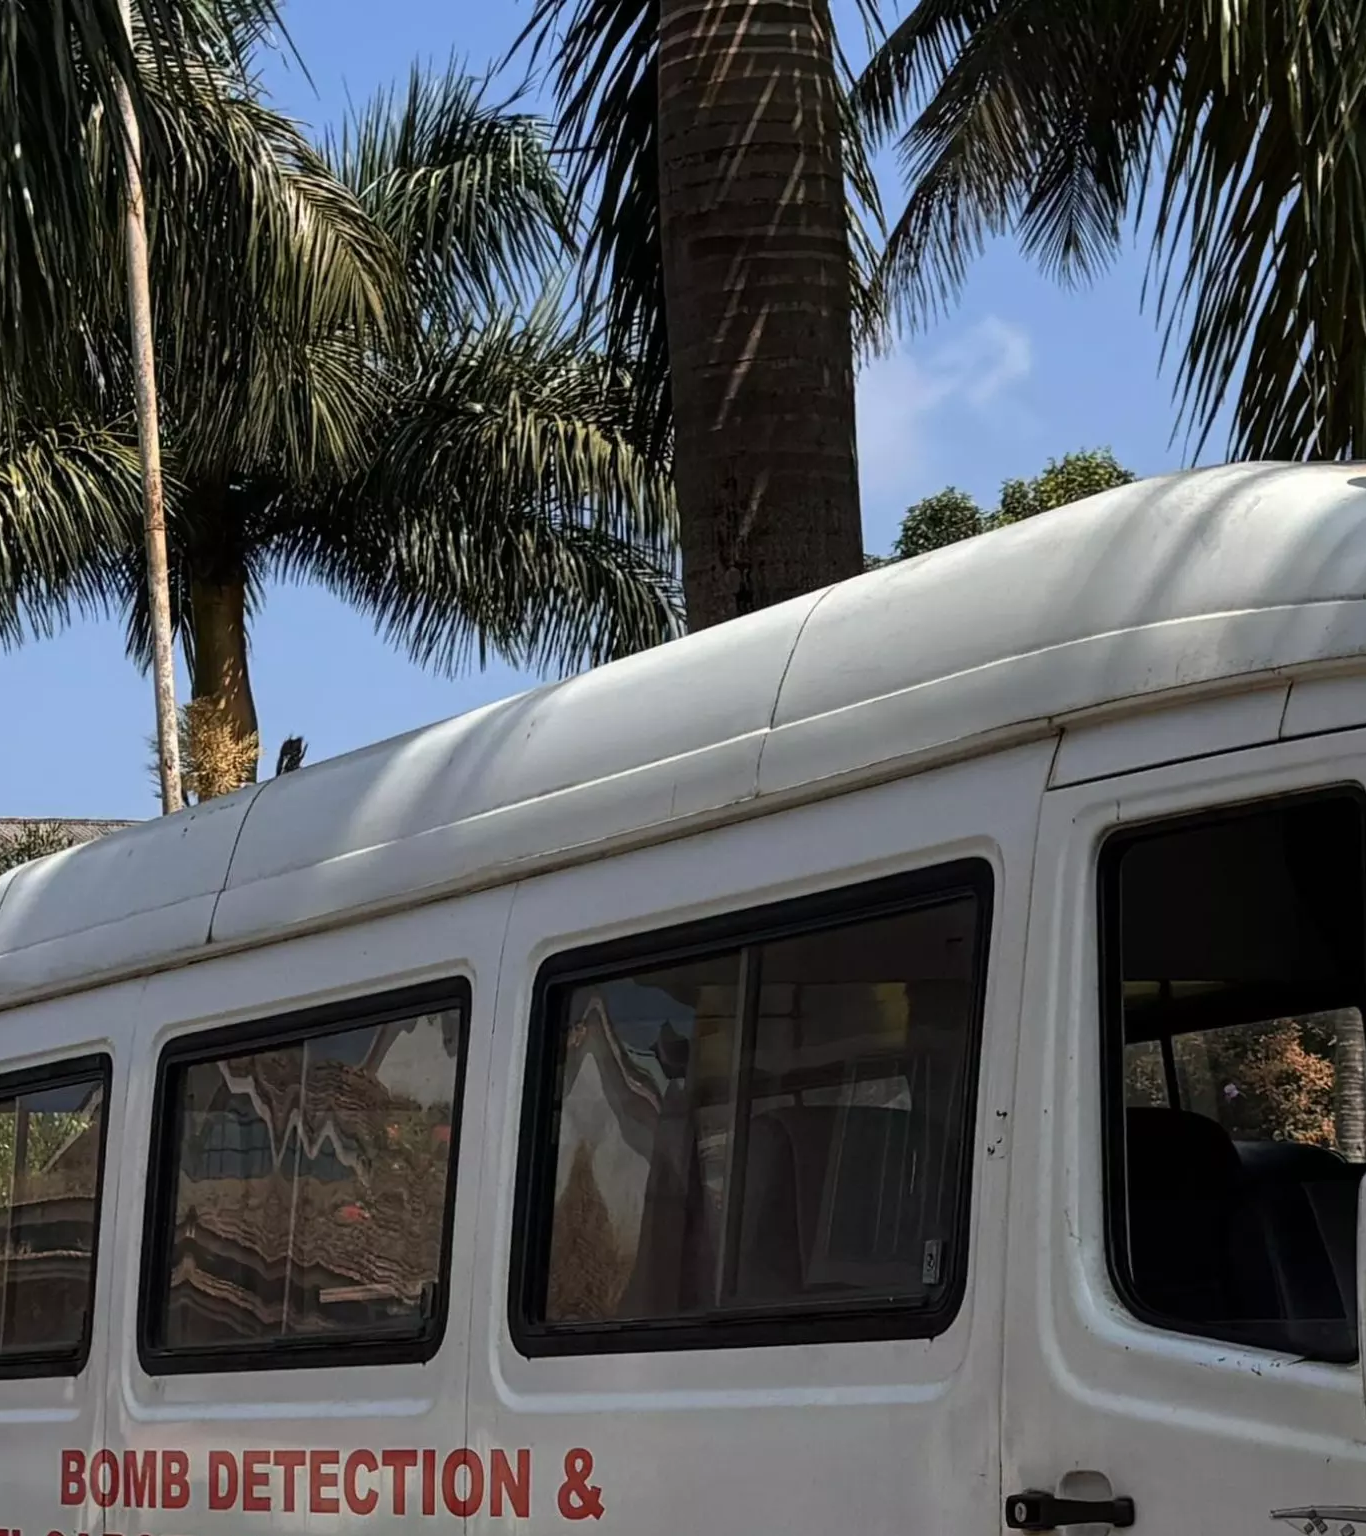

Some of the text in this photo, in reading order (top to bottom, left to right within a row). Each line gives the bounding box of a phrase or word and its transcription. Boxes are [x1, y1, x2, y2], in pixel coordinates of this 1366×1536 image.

[61, 1447, 605, 1521] BOMB DETECTION &
